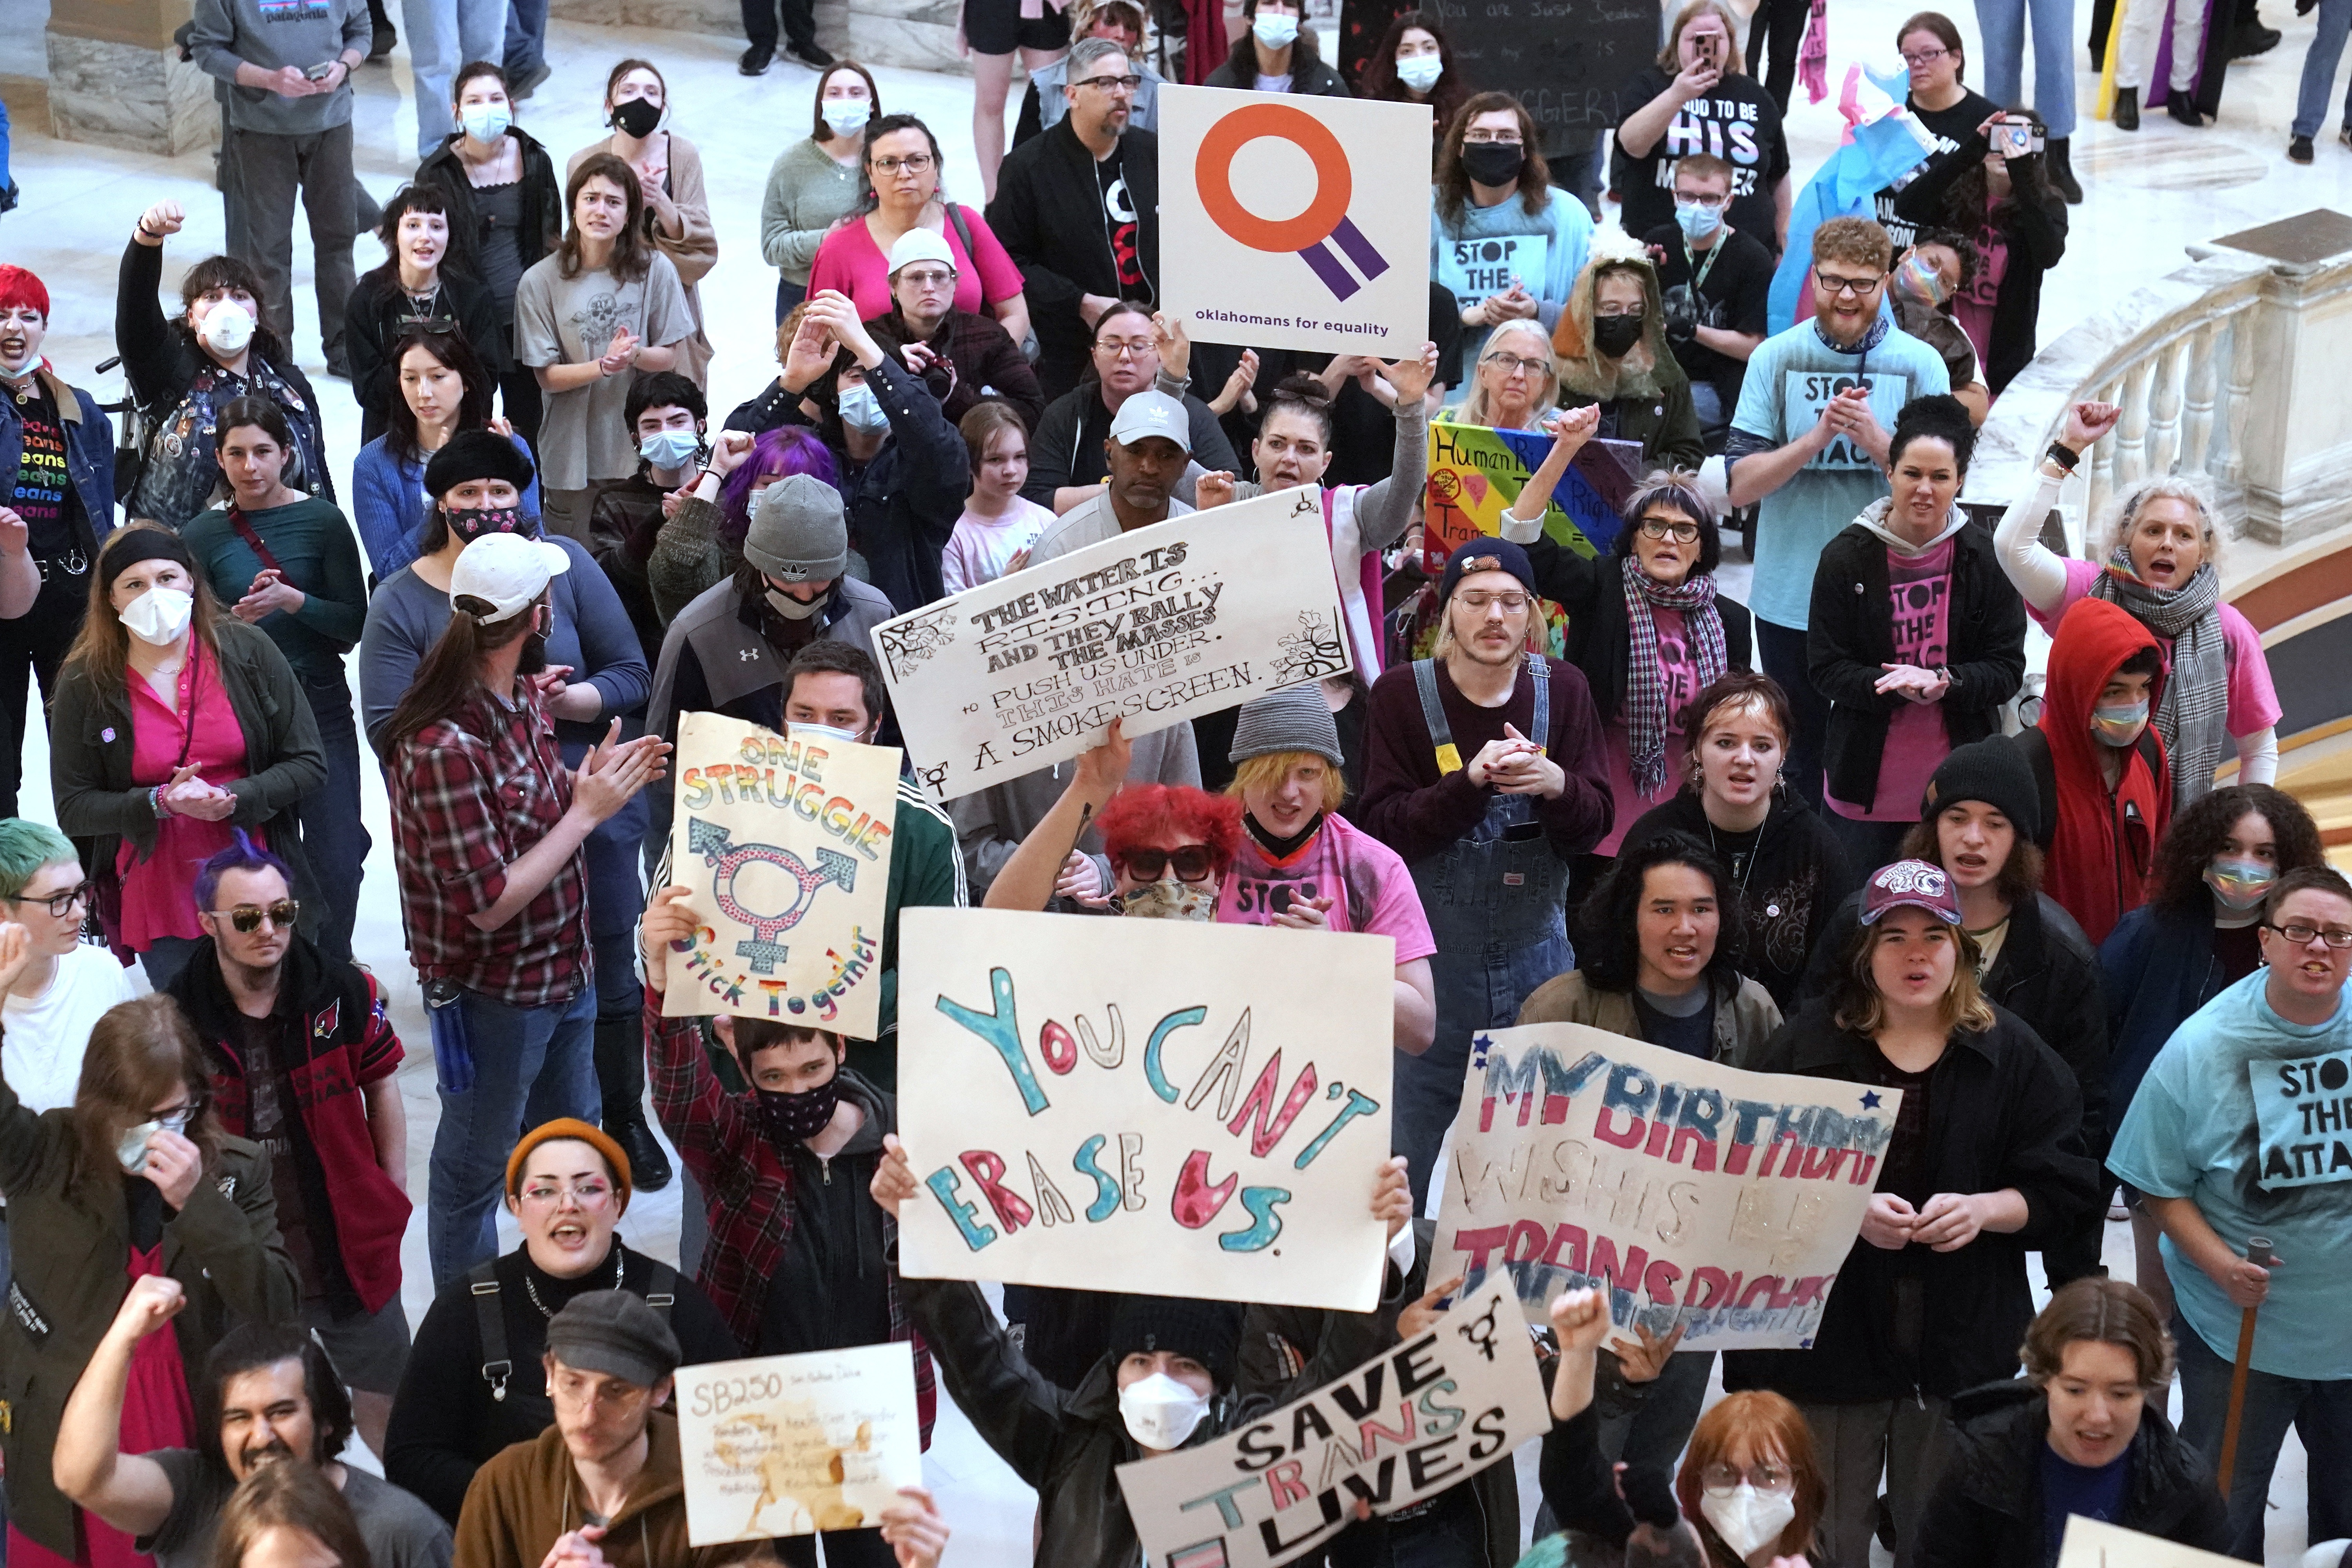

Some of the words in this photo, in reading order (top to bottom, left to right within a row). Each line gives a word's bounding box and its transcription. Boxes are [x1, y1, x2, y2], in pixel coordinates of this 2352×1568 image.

[266, 9, 328, 23] patagonia
[1715, 100, 1735, 119] TO
[1739, 102, 1759, 122] BE
[1666, 111, 1759, 165] HIS
[1655, 158, 1759, 196] MER
[1454, 240, 1517, 265] STOP
[1465, 267, 1510, 290] THE
[1195, 309, 1290, 327] oklahomans
[1296, 317, 1318, 329] for
[1324, 320, 1389, 338] equality
[255, 374, 263, 389] EOS
[1434, 428, 1509, 471] Human
[971, 592, 1038, 634] THE
[1038, 557, 1141, 610] WATER
[1140, 541, 1189, 576] IS
[1892, 581, 1945, 613] TOP
[987, 642, 1039, 674] AND
[1043, 613, 1125, 652] THEY
[1129, 582, 1223, 628] RALLY
[1048, 641, 1108, 670] THE
[1116, 606, 1216, 653] MASSES
[989, 671, 1073, 709] PUSH
[1081, 658, 1116, 681] US
[996, 686, 1083, 729] THIS
[1096, 658, 1177, 697] HATE
[1185, 652, 1202, 666] IS
[740, 737, 829, 783] ONE
[973, 740, 1003, 771] A
[1236, 880, 1318, 915] STOP
[759, 925, 877, 1022] Together
[1144, 1005, 1380, 1170] CAN'T
[1479, 1045, 1609, 1133] MY
[2279, 1058, 2352, 1098] STO
[2264, 1140, 2352, 1181] ATTA
[925, 1132, 1146, 1252] ERASE
[691, 1372, 783, 1417] SB250
[1234, 1333, 1446, 1472] SAVE
[1180, 1379, 1466, 1530] TRANS
[1258, 1406, 1506, 1558] LIVES
